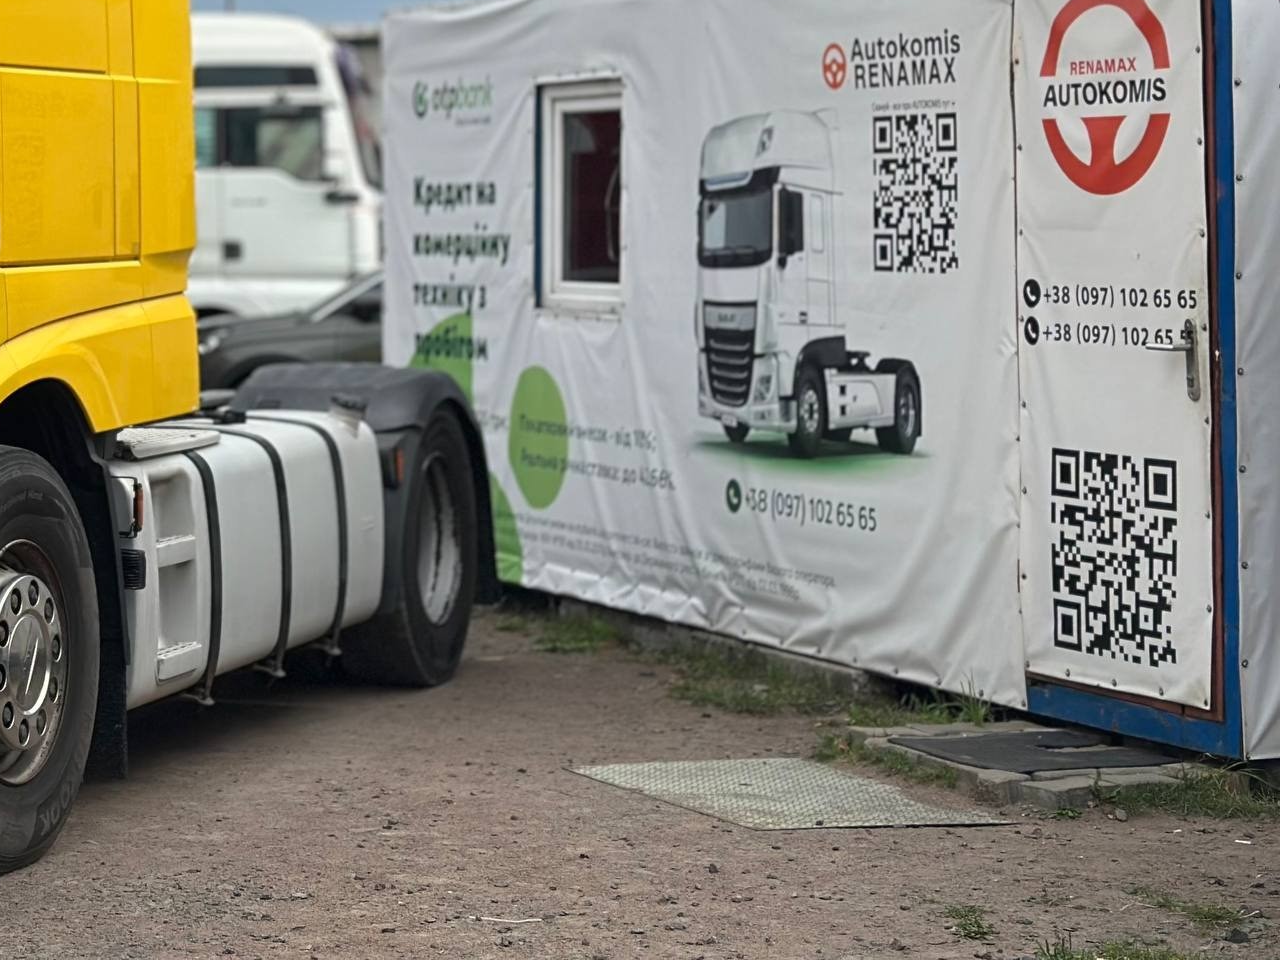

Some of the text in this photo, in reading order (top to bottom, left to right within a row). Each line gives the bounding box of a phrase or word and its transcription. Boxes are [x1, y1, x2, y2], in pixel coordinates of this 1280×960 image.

[851, 28, 961, 62] Autokomis
[854, 57, 957, 90] RENAMAX
[1069, 57, 1137, 76] RENAMAX
[1043, 77, 1167, 108] AUTOKOMIS
[413, 177, 496, 215] Кредит на
[1043, 284, 1197, 309] +38 (097) 102 65 65
[1043, 323, 1072, 342] +38
[1077, 323, 1116, 347] (097)
[1122, 326, 1149, 346] 102
[1154, 328, 1173, 346] 65
[771, 489, 806, 526] (097)
[809, 497, 833, 524] 102
[836, 502, 855, 528] 65
[858, 505, 877, 532] 65
